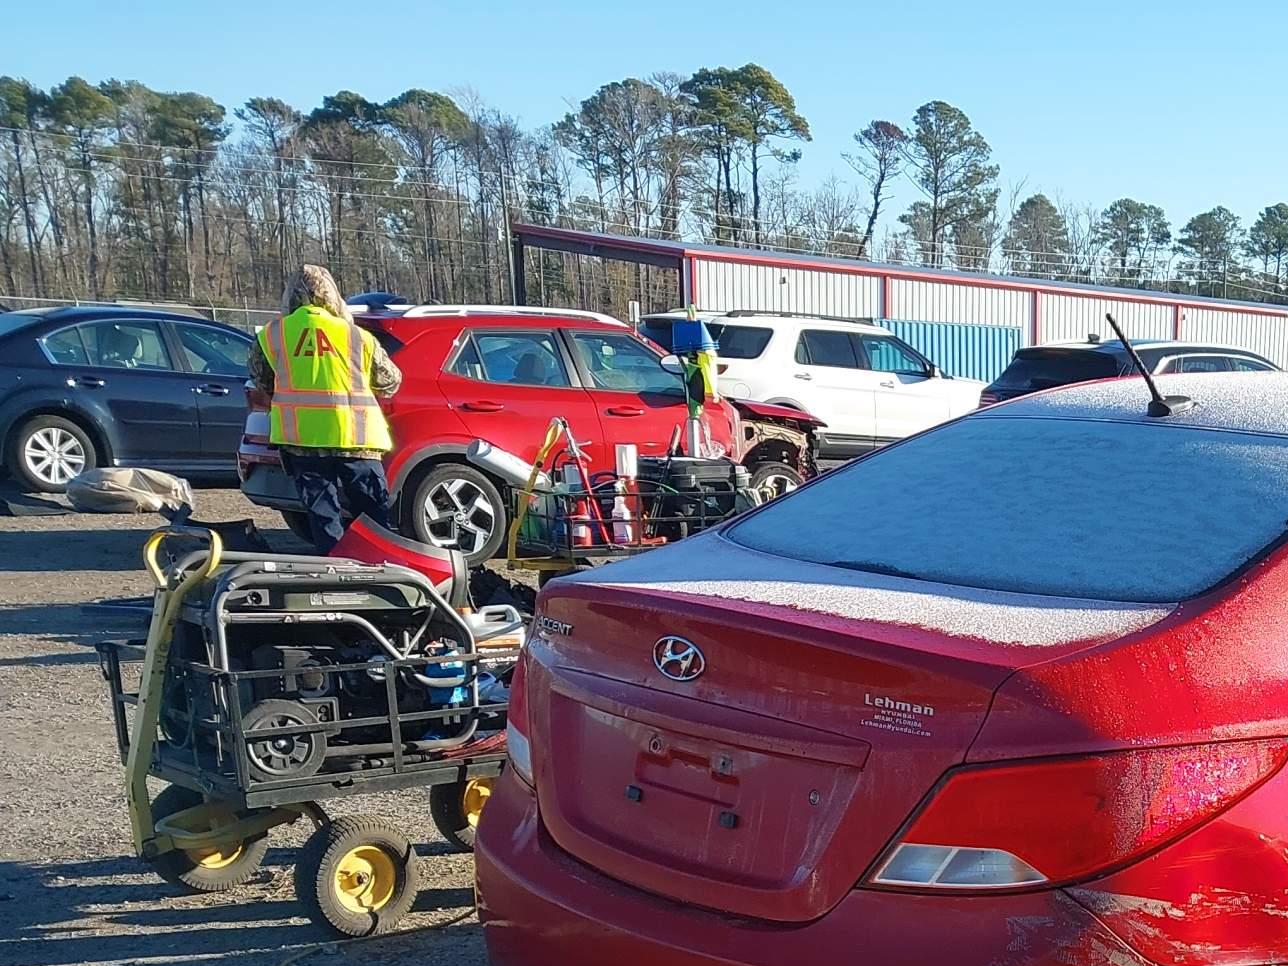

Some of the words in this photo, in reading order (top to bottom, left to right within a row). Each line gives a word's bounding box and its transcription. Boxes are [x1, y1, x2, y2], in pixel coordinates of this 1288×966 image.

[538, 616, 574, 636] ACCENT
[864, 693, 934, 716] Lehman
[874, 714, 895, 724] MIAMI,
[895, 719, 922, 728] FLORIDA
[881, 710, 915, 720] HYUNDAI
[860, 719, 931, 737] LehmanHyundai.com
